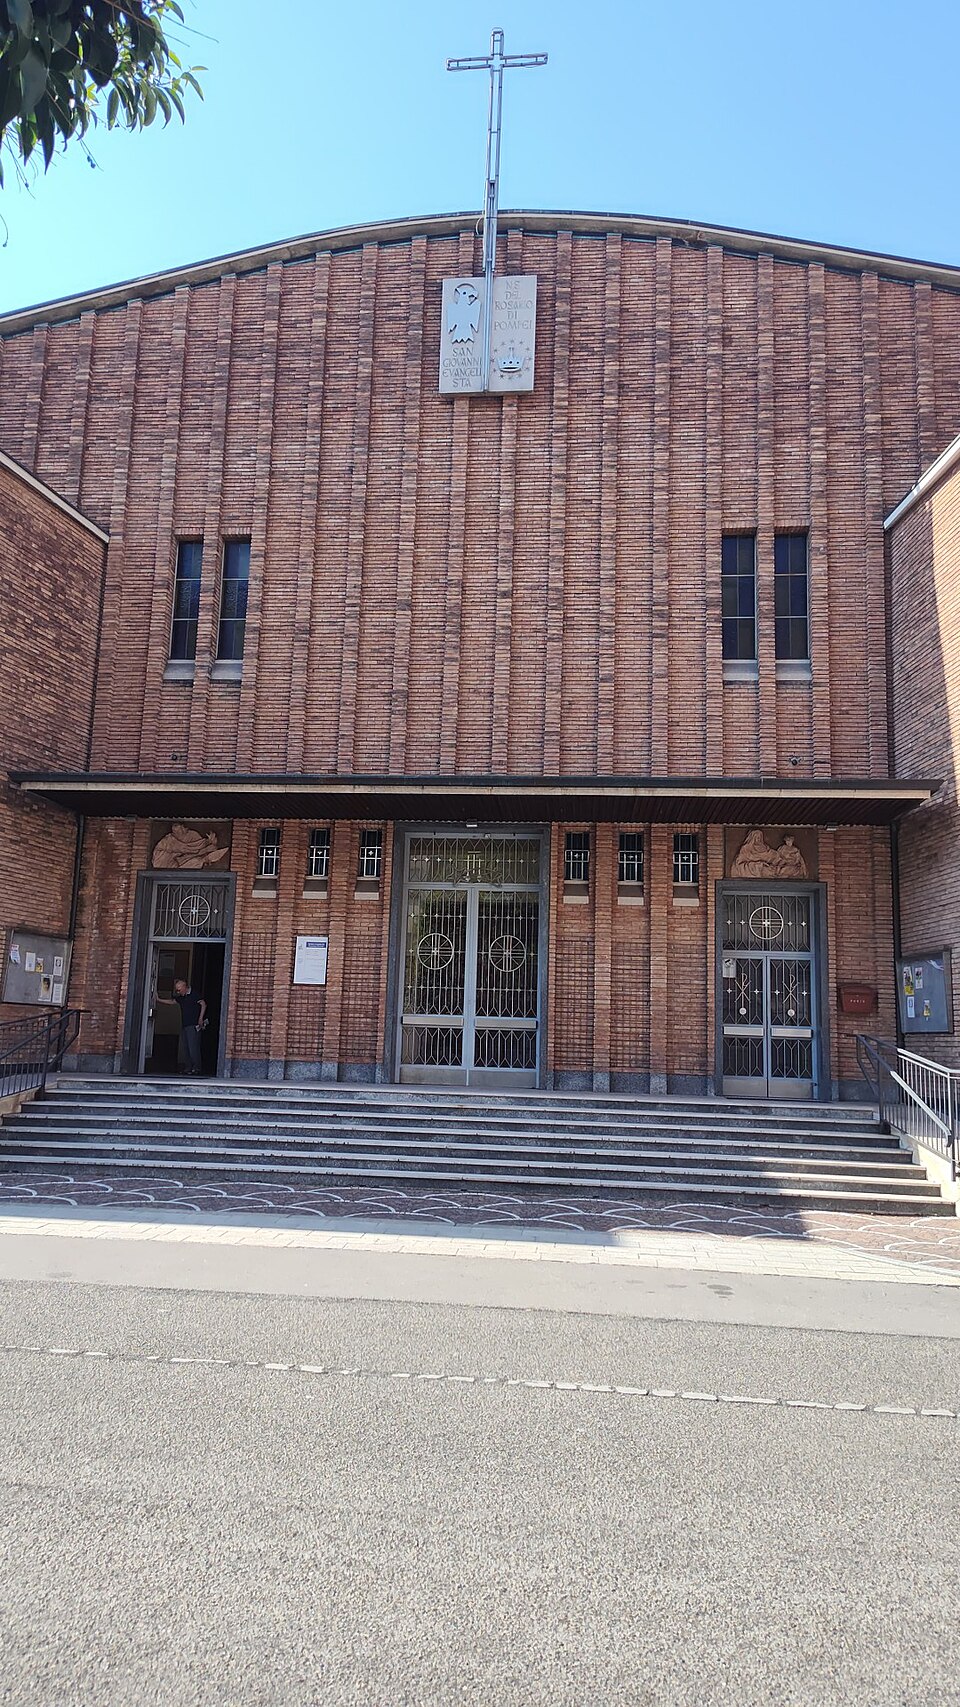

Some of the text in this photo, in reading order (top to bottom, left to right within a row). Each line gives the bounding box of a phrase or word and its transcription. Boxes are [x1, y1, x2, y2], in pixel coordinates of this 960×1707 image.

[504, 291, 521, 300] DEL
[507, 310, 518, 320] DI
[452, 347, 474, 357] SAN
[442, 357, 482, 367] GIOVANNI
[442, 367, 482, 377] EVANGELI
[452, 377, 472, 388] STA
